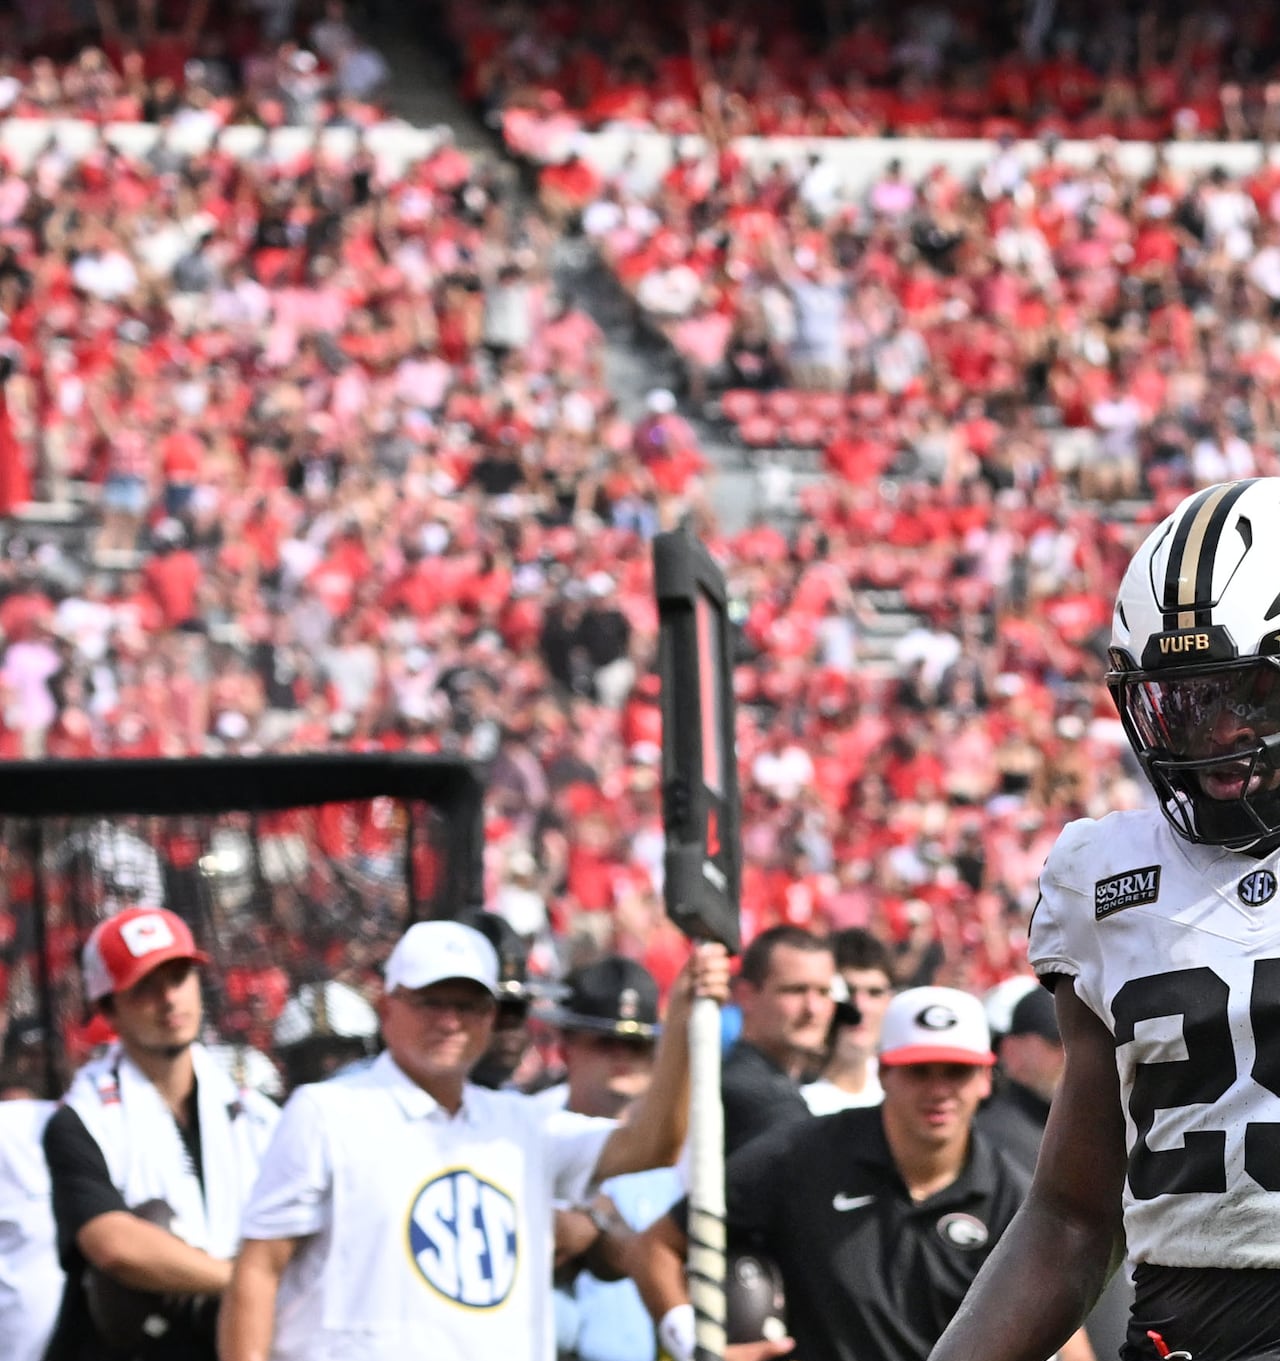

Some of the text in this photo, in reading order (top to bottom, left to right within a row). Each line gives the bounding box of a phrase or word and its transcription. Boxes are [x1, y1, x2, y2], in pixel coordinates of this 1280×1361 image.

[1159, 633, 1210, 654] VUFB
[1096, 890, 1155, 914] CONCRETE
[1105, 870, 1157, 903] SRM
[1240, 871, 1274, 904] SEC
[411, 1172, 518, 1306] SEC
